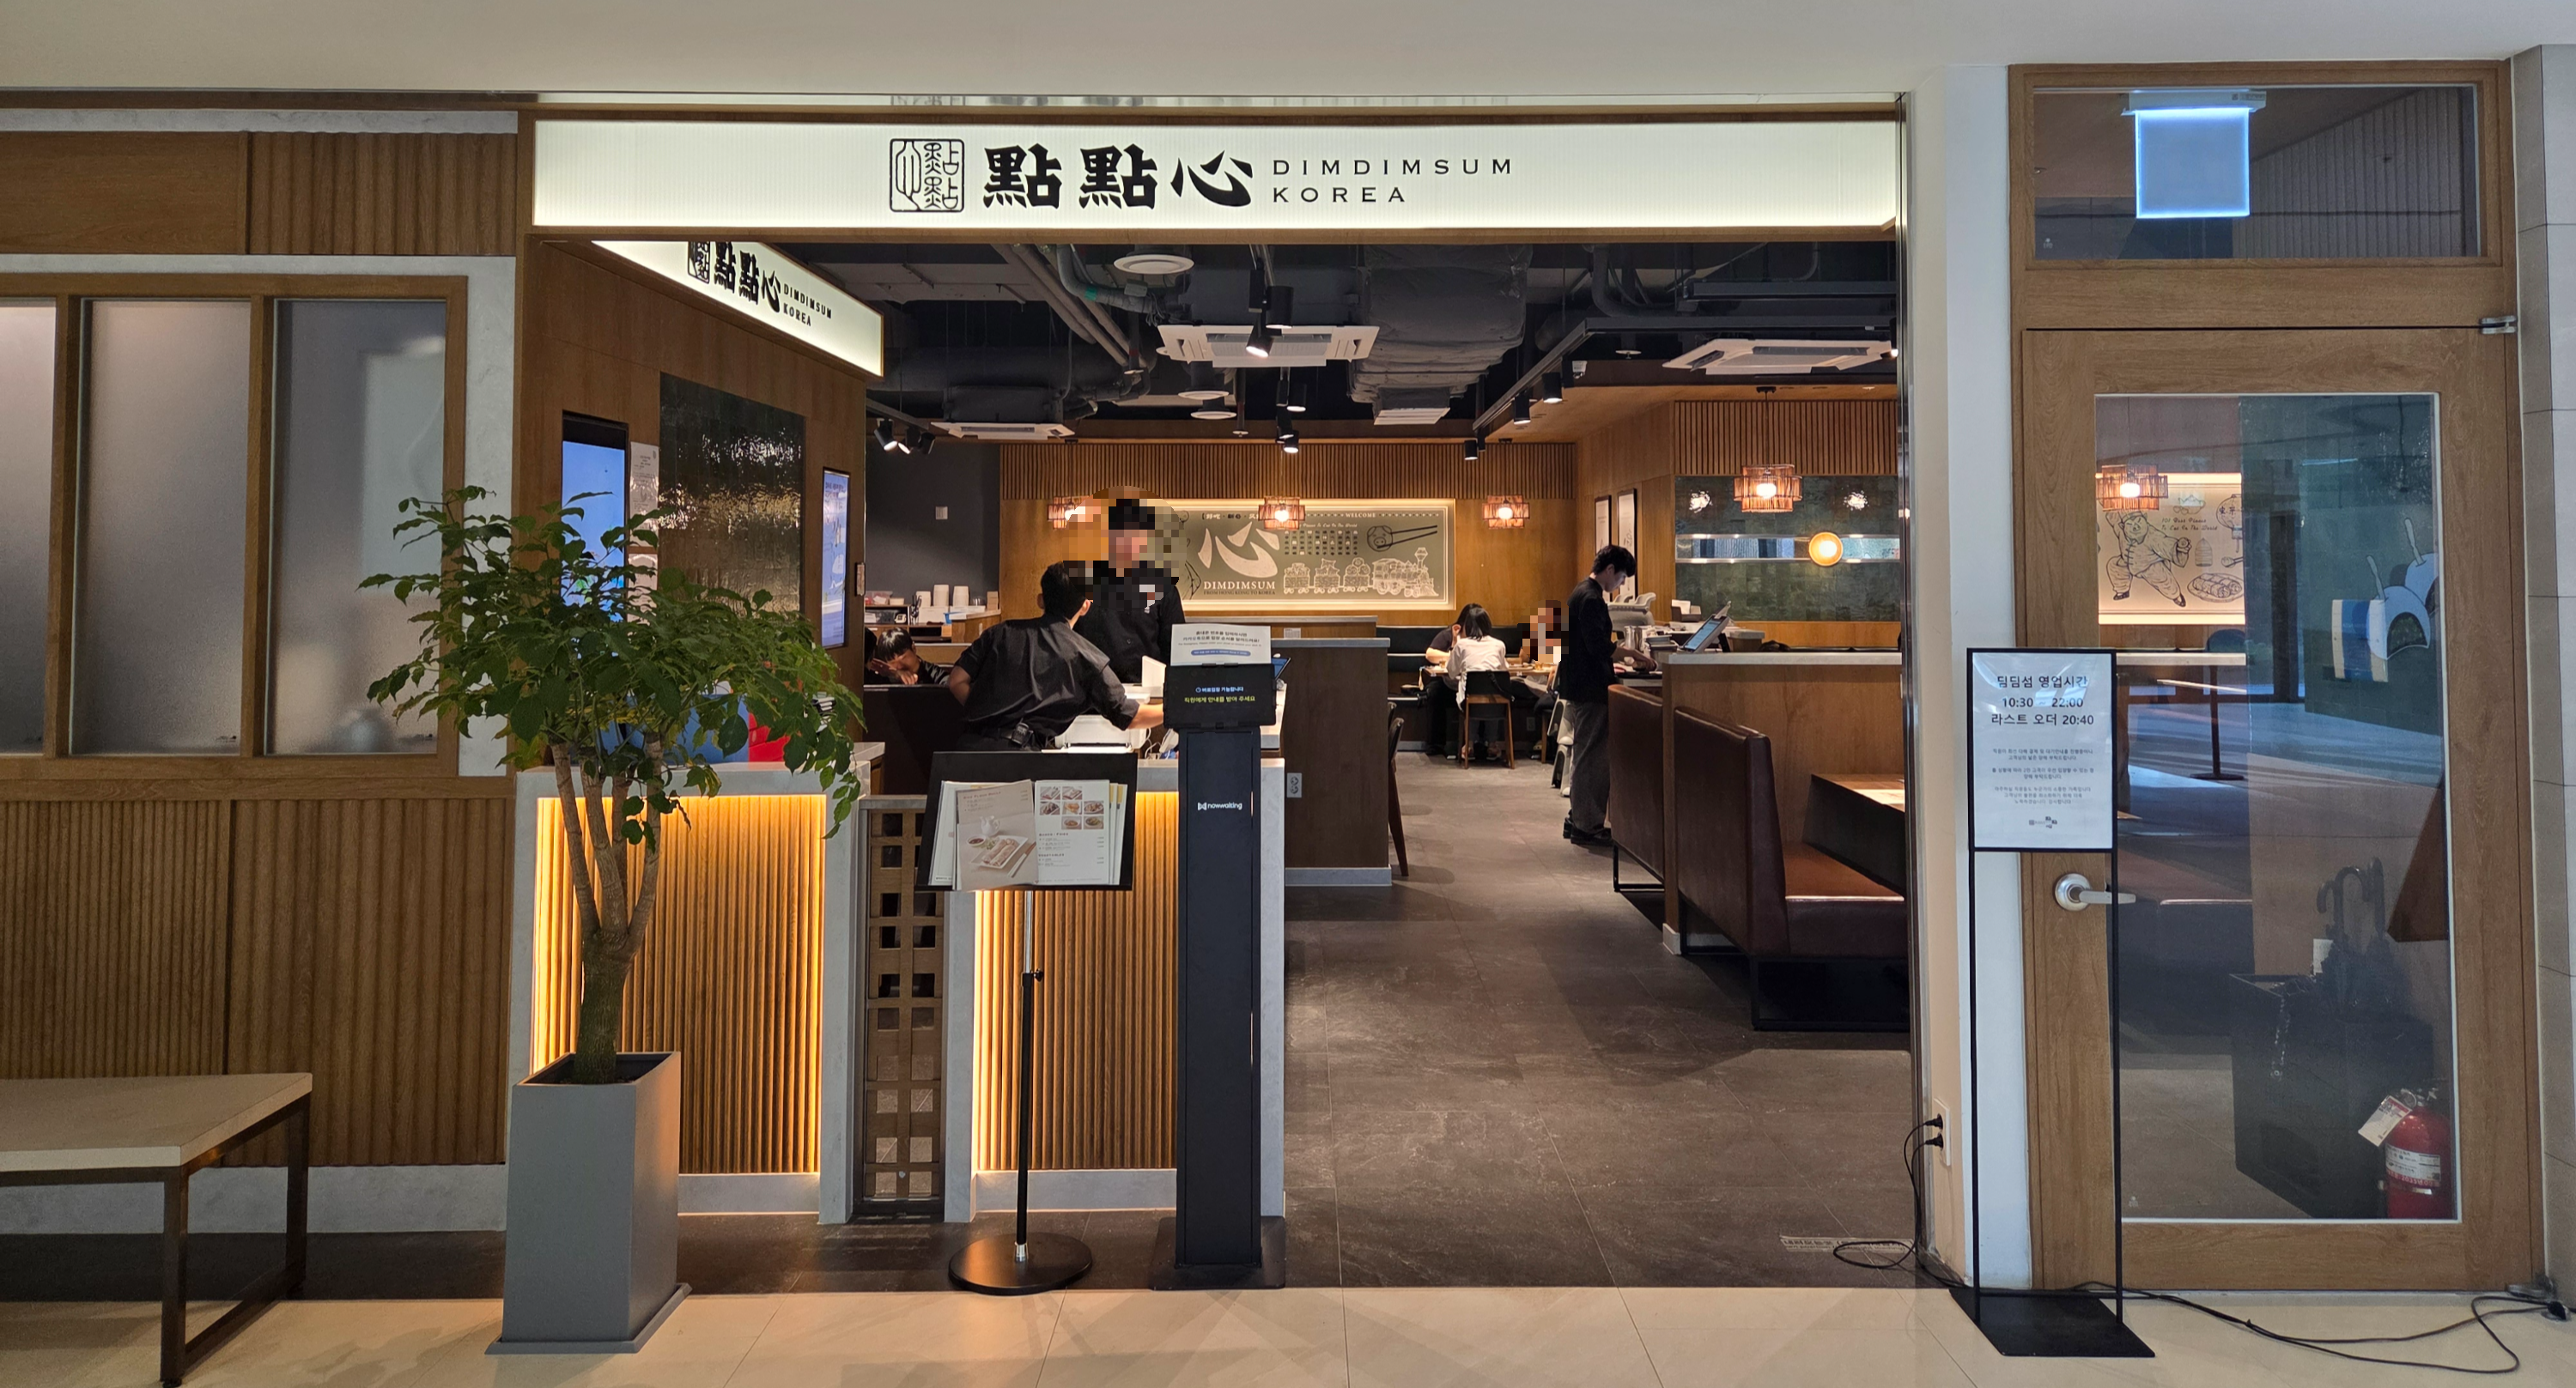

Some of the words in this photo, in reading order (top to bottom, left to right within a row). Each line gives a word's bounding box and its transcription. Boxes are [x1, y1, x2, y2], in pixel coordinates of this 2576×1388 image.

[1273, 160, 1512, 176] DIMDIMSUM
[983, 143, 1255, 209] 點點心
[1273, 186, 1406, 203] KOREA
[783, 283, 832, 319] DIMDIMSUM
[783, 303, 812, 327] KOREA
[1204, 581, 1275, 590] DIMDIMSUM
[1997, 676, 2033, 688] 딤딤섬
[2038, 676, 2088, 688] 영업시간
[2002, 697, 2033, 708] 10:30
[2051, 697, 2083, 708] 22:00
[1991, 713, 2028, 726] 라스트
[2032, 713, 2057, 726] 오더
[2063, 714, 2094, 725] 20:40
[1207, 802, 1242, 810] nowwaiting
